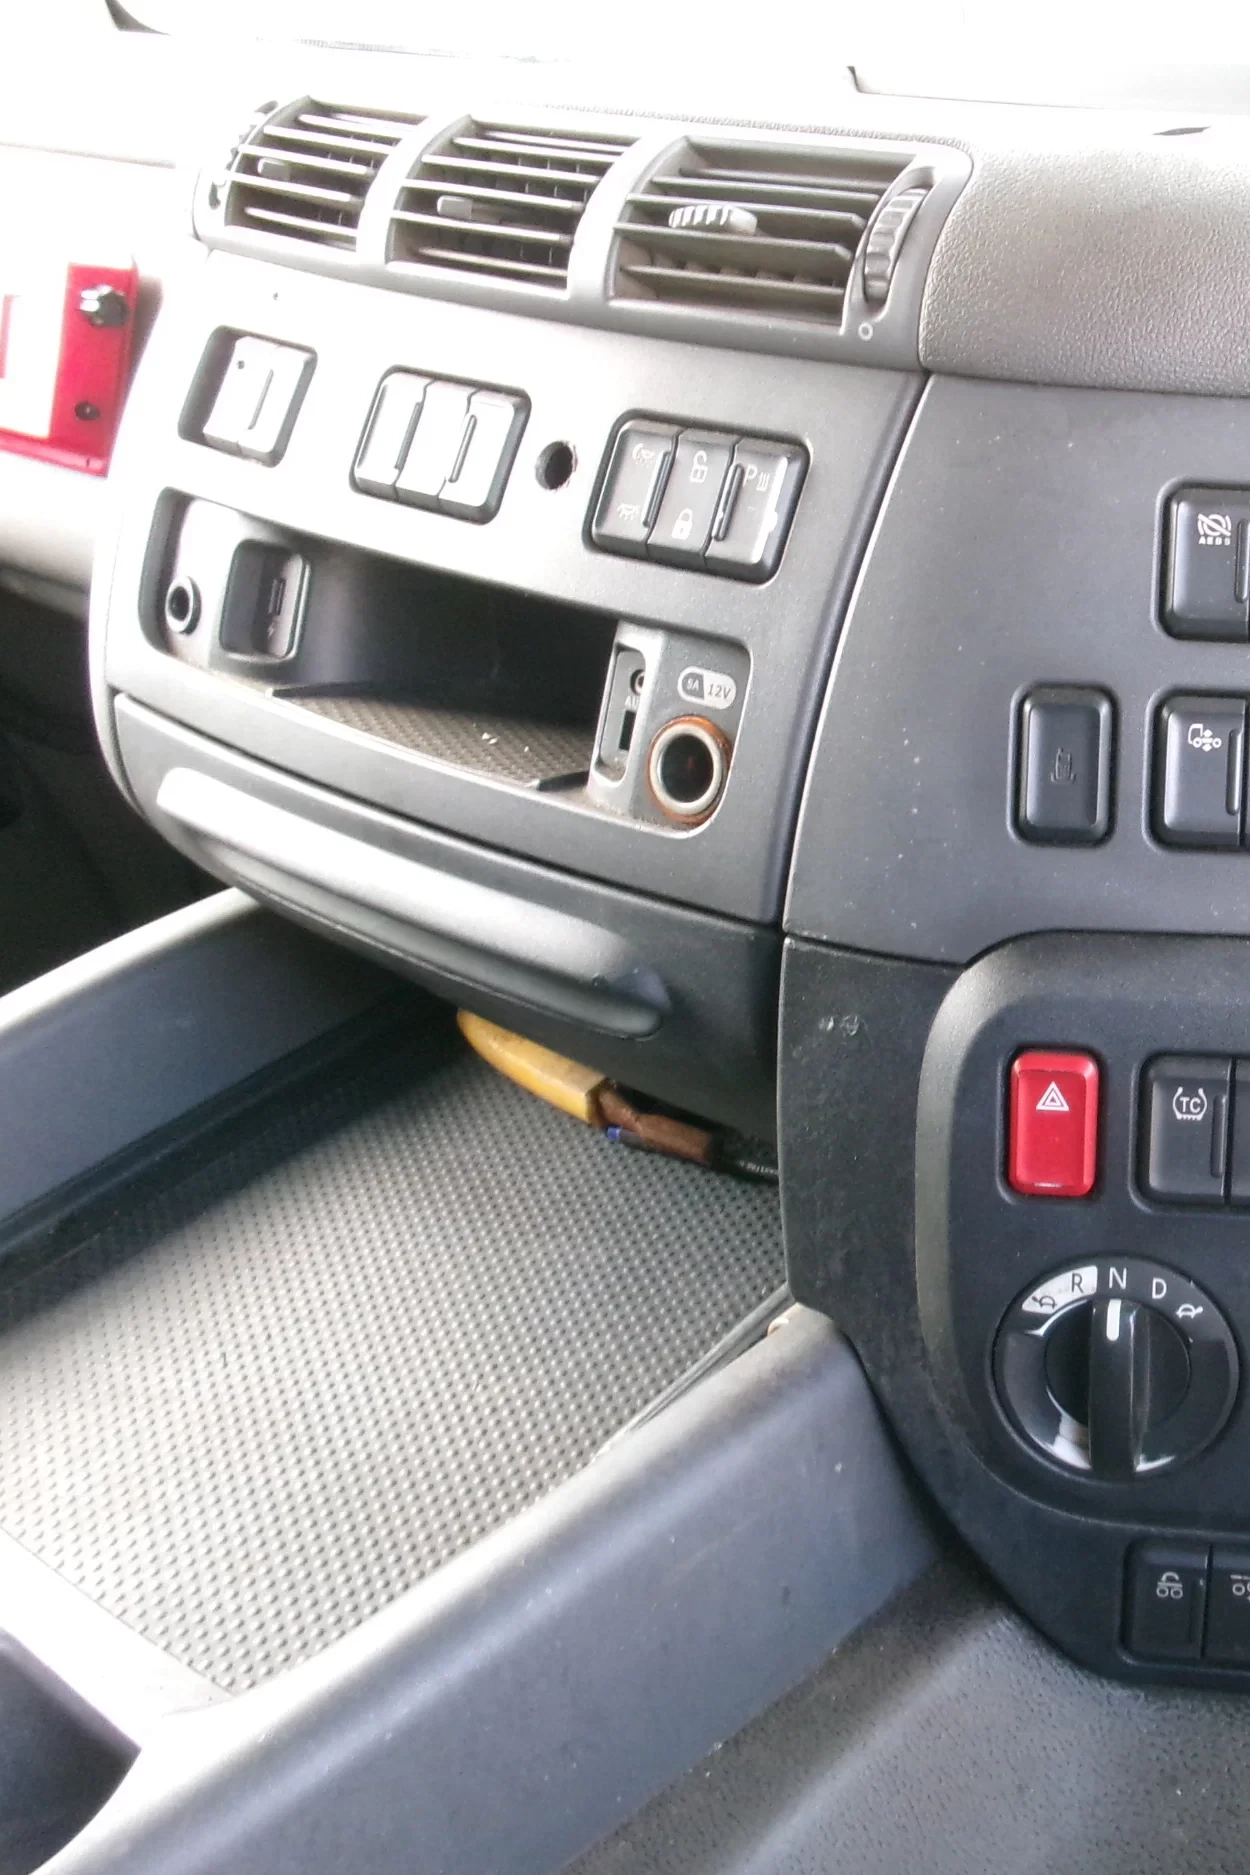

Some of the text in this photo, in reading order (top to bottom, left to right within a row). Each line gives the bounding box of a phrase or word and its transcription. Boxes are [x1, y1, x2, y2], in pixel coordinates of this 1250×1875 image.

[708, 683, 732, 699] 12V
[1180, 1097, 1201, 1114] TC
[1071, 1273, 1083, 1293] R
[1108, 1268, 1126, 1289] N
[1152, 1278, 1167, 1299] D
